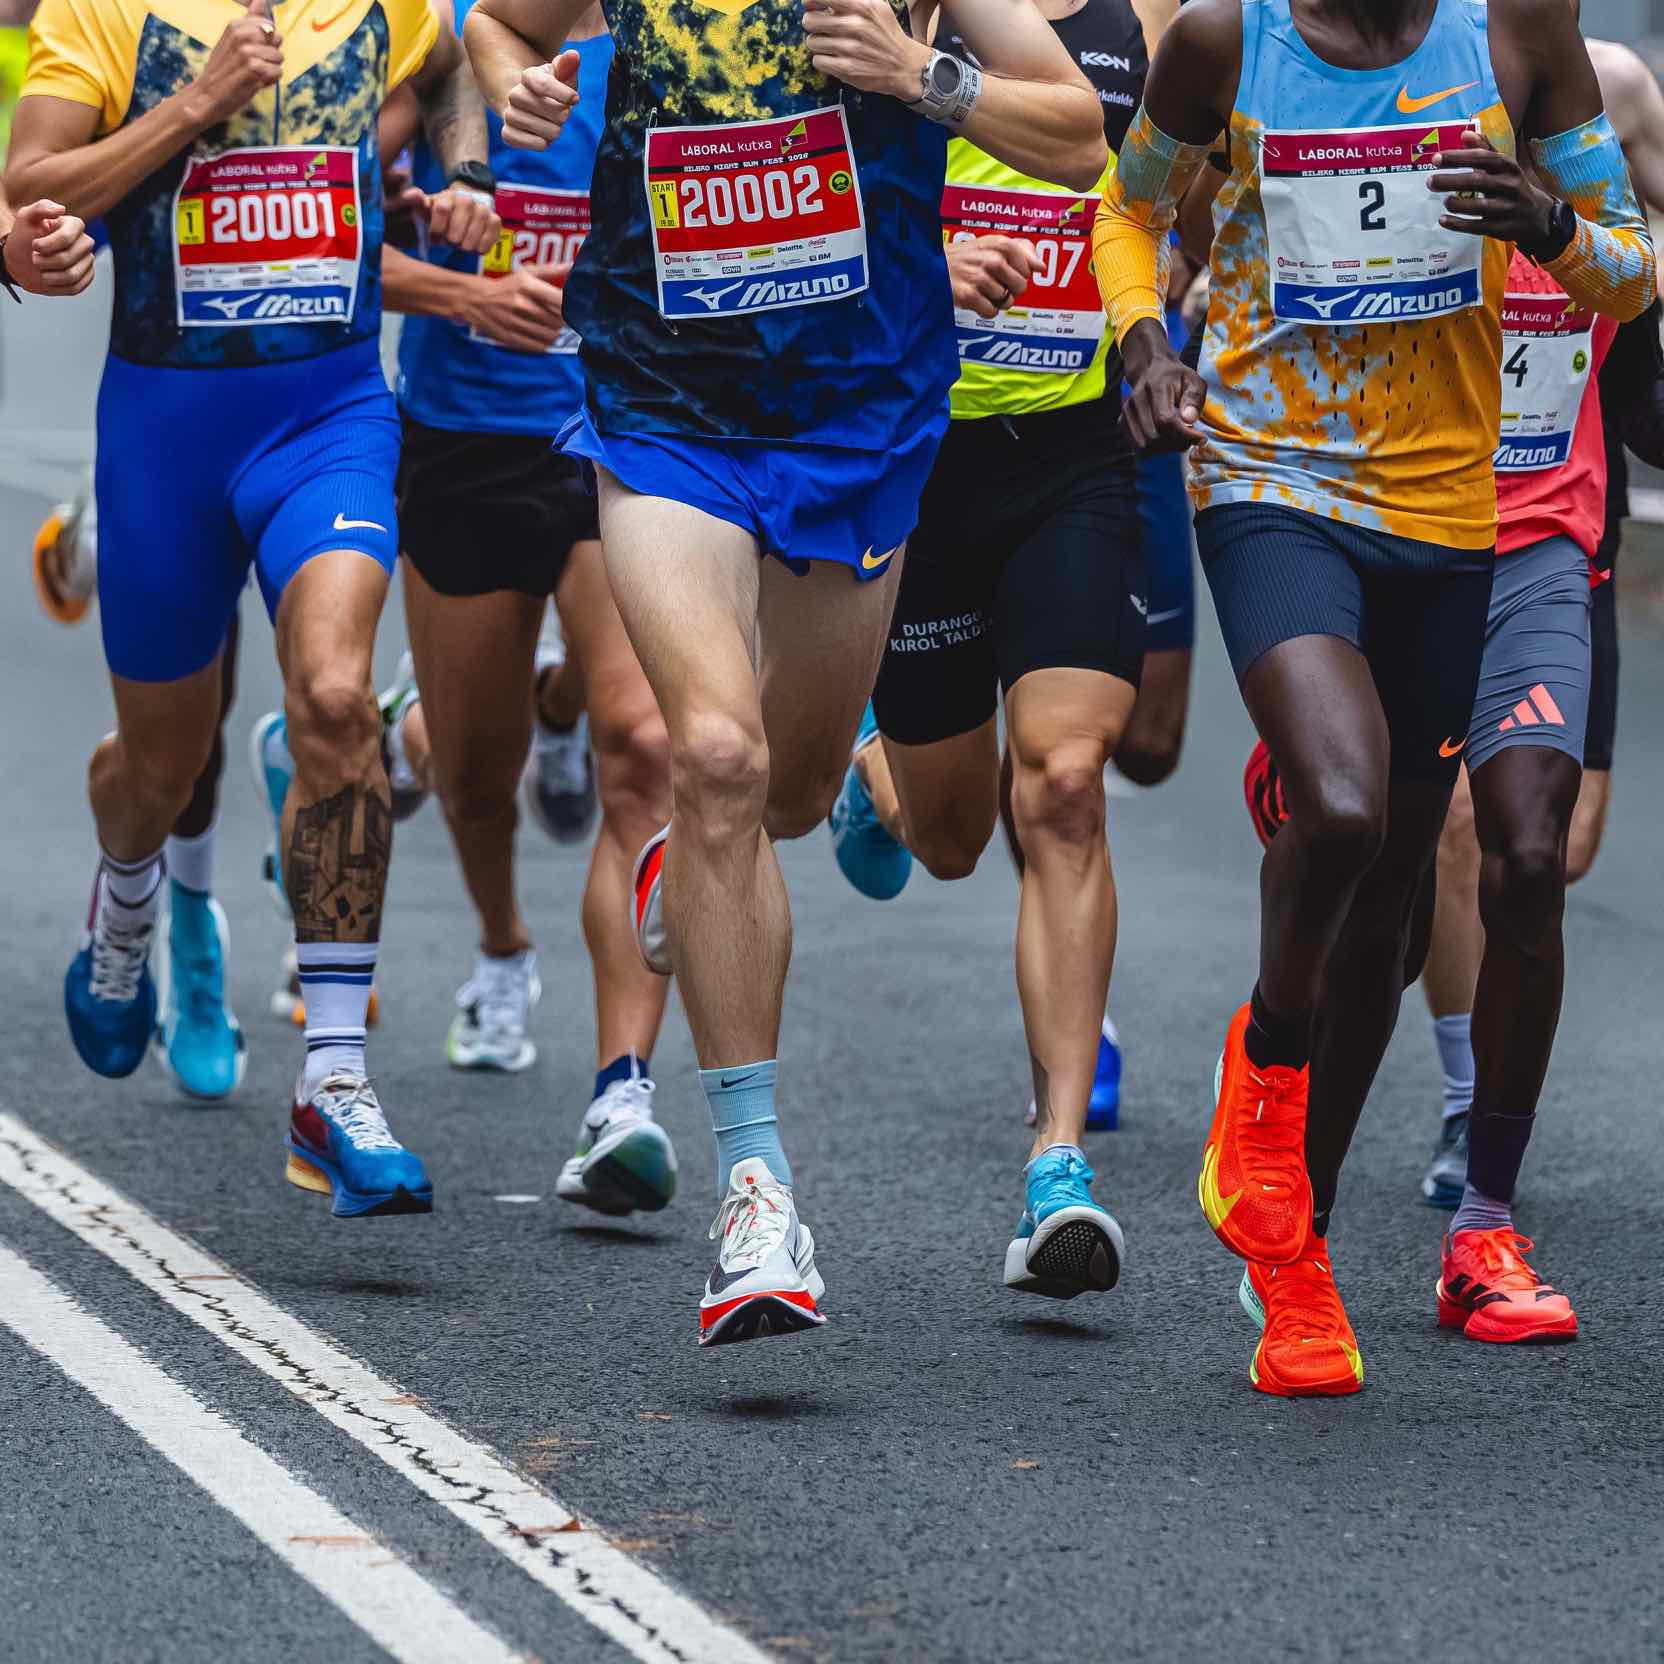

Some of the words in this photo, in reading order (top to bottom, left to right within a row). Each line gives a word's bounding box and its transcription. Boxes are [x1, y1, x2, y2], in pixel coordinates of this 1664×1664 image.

[681, 142, 735, 156] LABORAL
[738, 140, 772, 152] kutxa
[1299, 148, 1362, 160] LABORAL
[1366, 145, 1402, 157] kutxa
[211, 163, 264, 177] LABORAL
[743, 160, 758, 168] RUN
[763, 157, 784, 165] FEST
[651, 183, 675, 193] START
[681, 165, 824, 227] 20002
[659, 194, 668, 218] 1
[961, 200, 1018, 216] LABORAL
[1021, 206, 1052, 219] kutxa
[1359, 181, 1386, 231] 2
[186, 211, 193, 234] 1
[211, 192, 336, 243] 20001
[1523, 312, 1552, 322] kutxa
[1503, 343, 1529, 387] 4
[890, 638, 941, 651] KIROL
[944, 620, 990, 645] TALD
